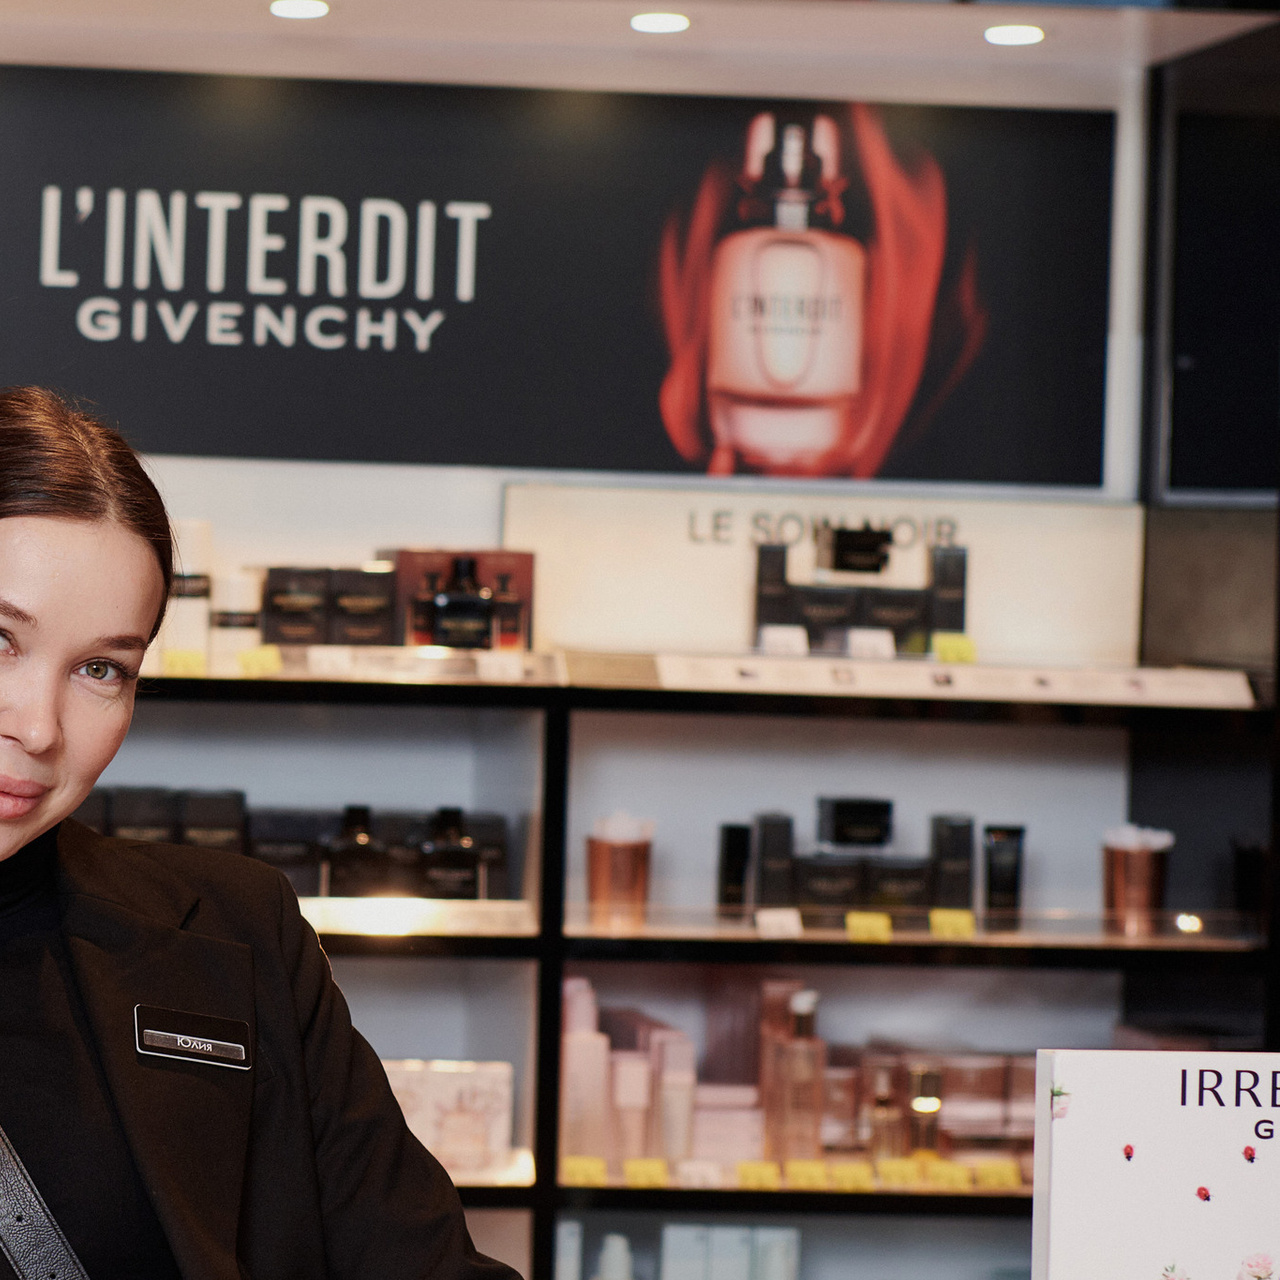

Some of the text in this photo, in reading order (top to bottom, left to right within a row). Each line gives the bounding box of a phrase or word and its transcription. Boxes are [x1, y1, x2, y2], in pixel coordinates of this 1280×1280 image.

[39, 185, 492, 302] L'INTERDIT
[76, 296, 446, 352] GIVENCHY
[688, 510, 733, 544] LE
